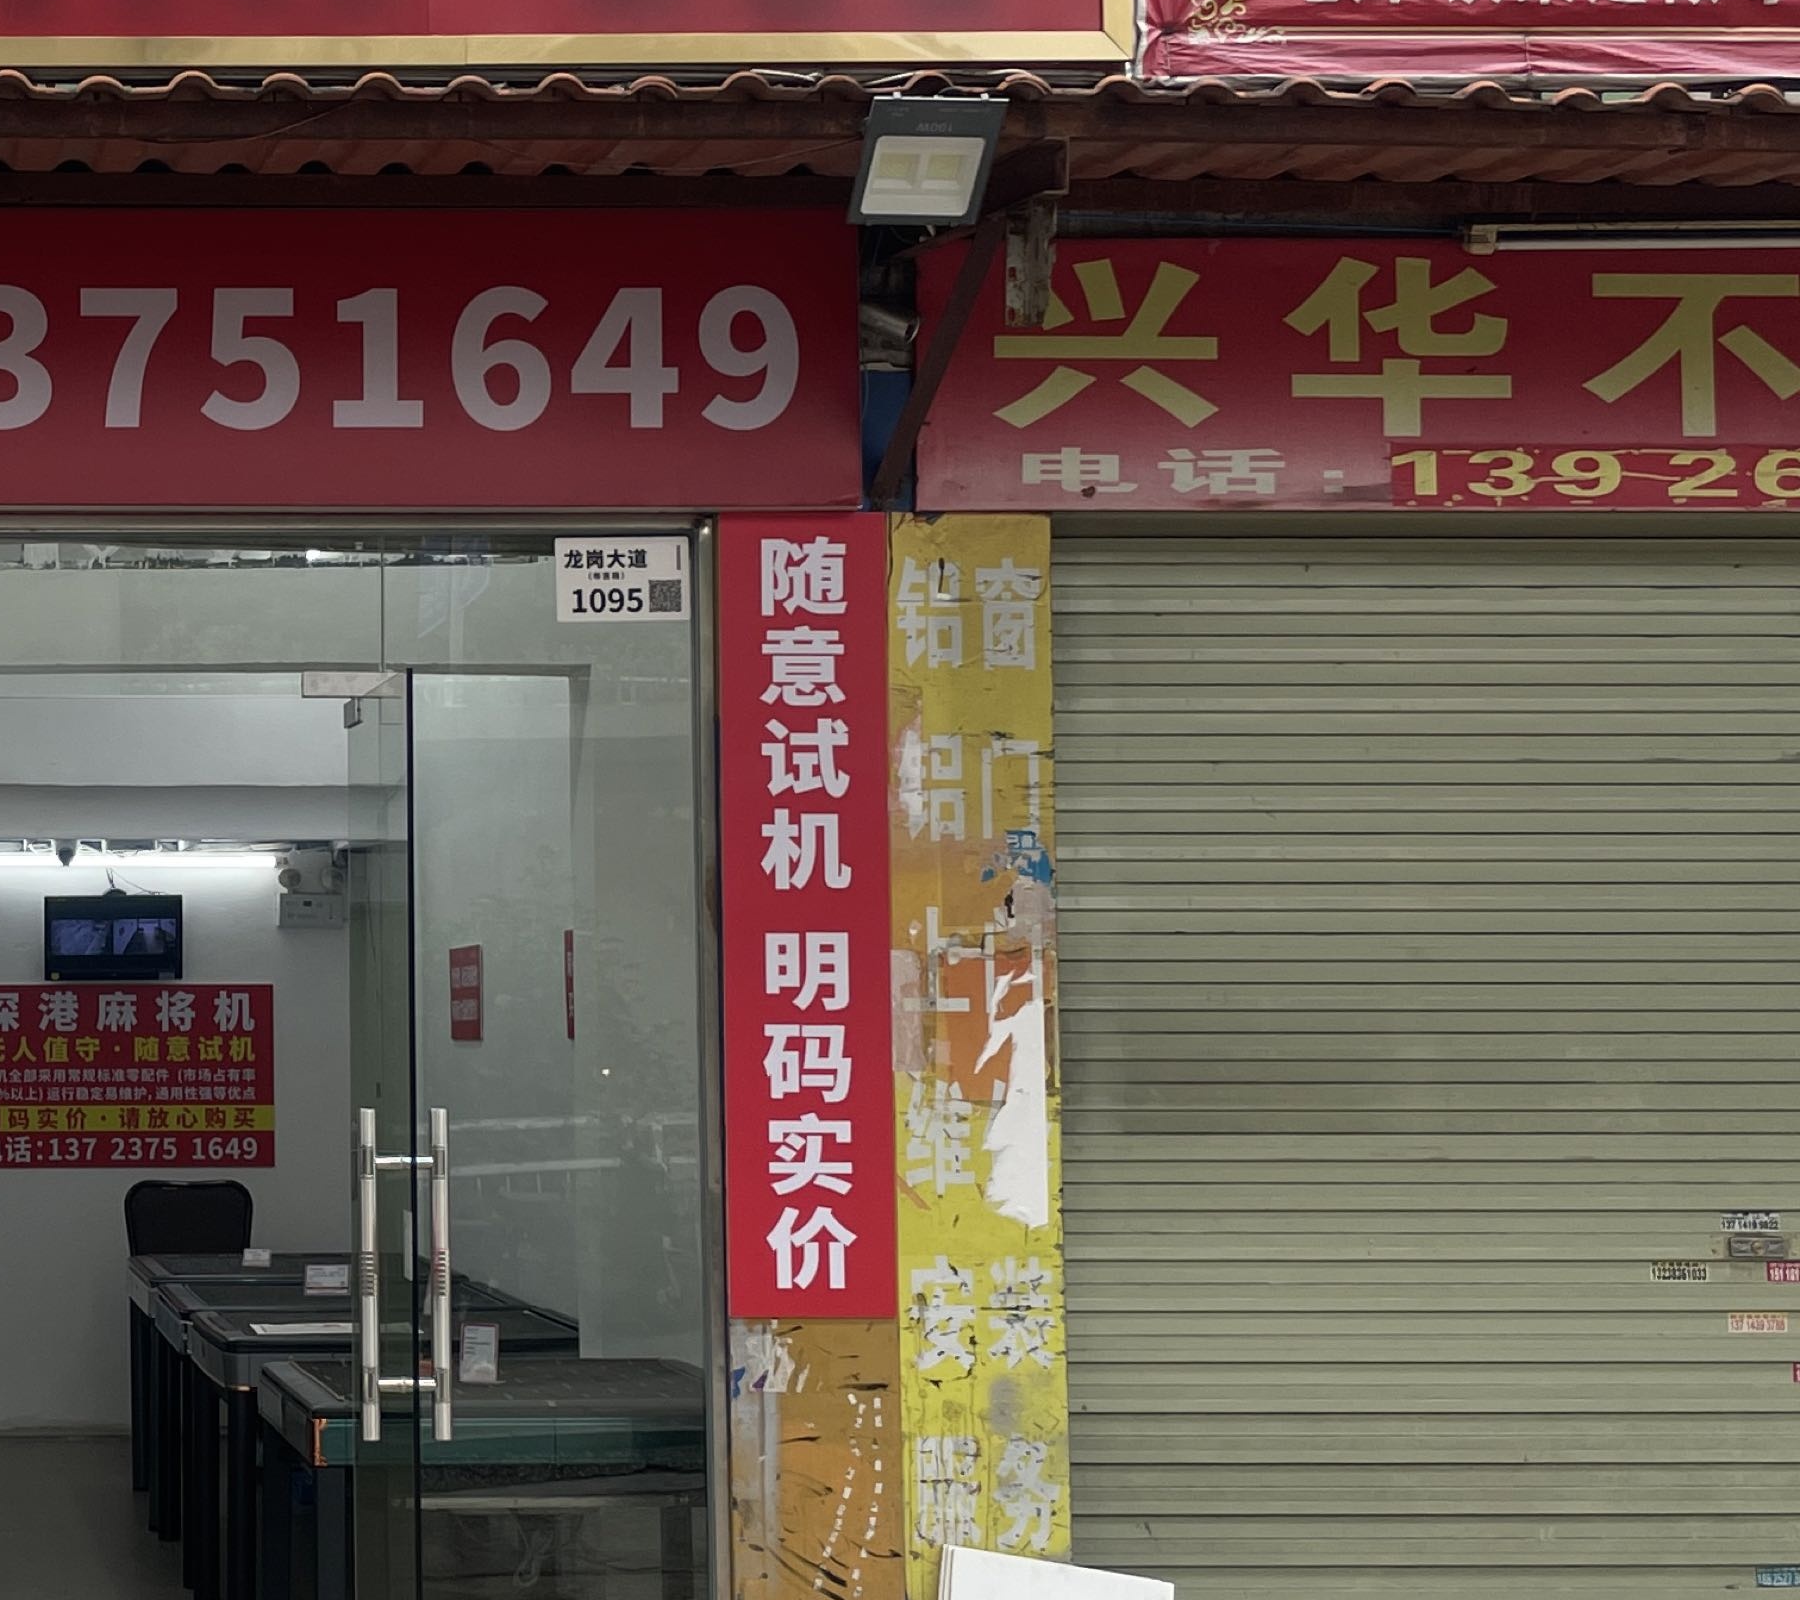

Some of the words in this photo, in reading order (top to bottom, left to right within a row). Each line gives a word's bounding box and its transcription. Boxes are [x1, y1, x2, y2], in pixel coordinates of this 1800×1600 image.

[993, 255, 1800, 438] 兴华不
[563, 548, 648, 570] 龙岗大道
[572, 588, 644, 614] 1095
[759, 537, 852, 891] 随意试机
[110, 1136, 178, 1162] 2375
[191, 1136, 258, 1162] 1649
[763, 930, 858, 1291] 明码实价
